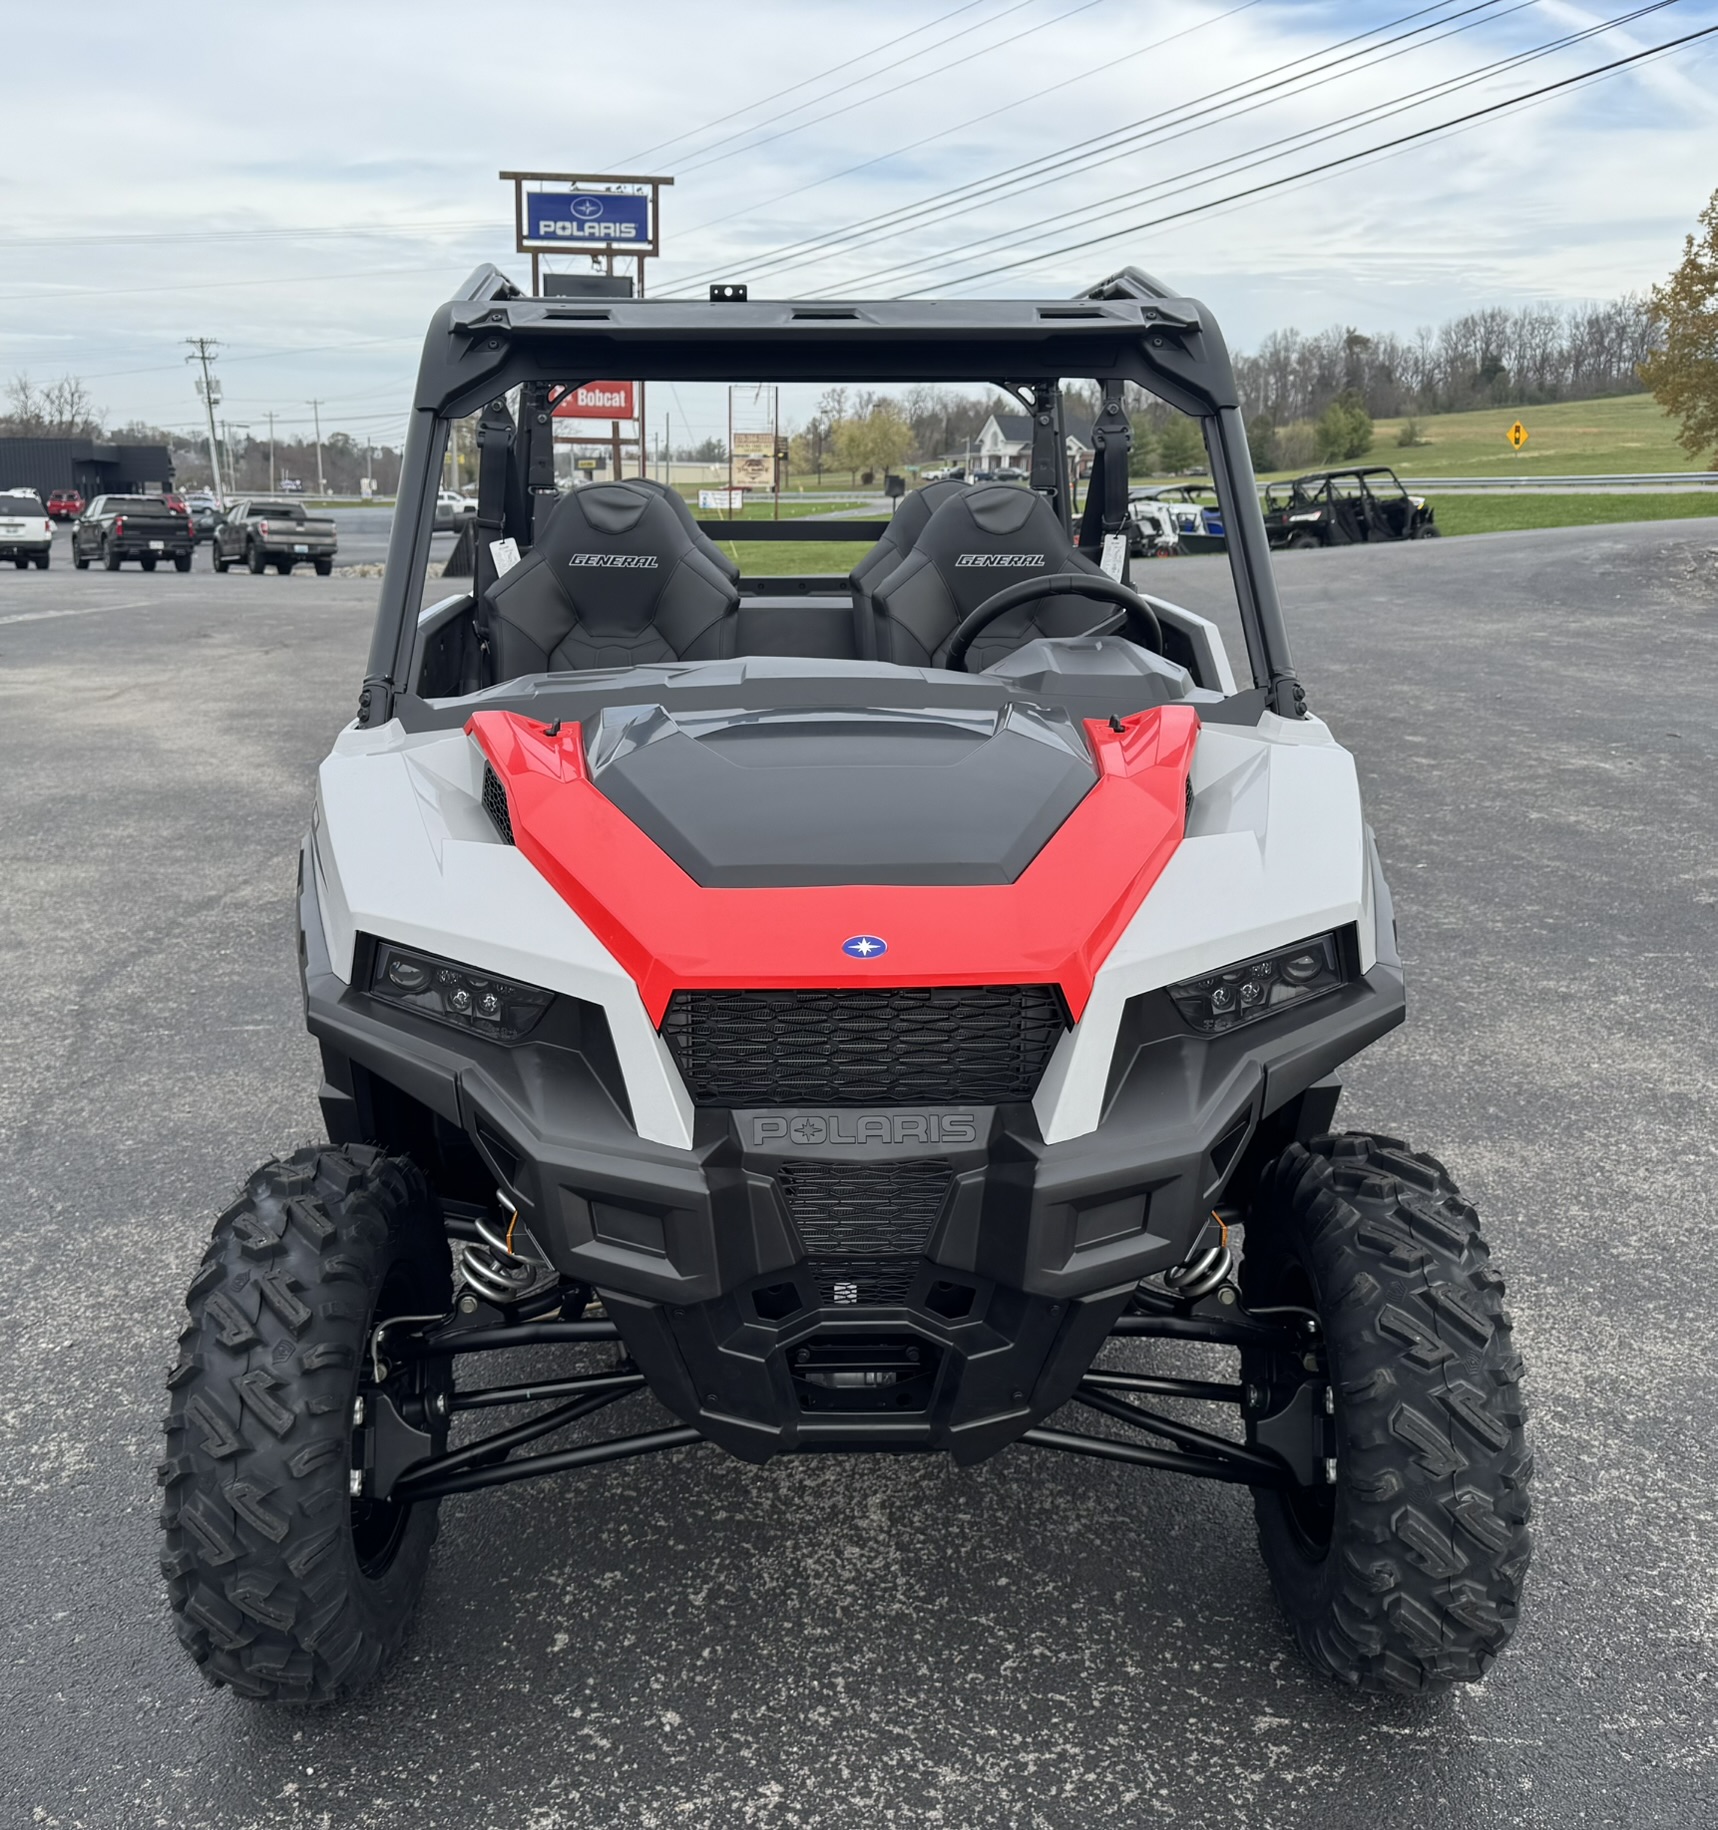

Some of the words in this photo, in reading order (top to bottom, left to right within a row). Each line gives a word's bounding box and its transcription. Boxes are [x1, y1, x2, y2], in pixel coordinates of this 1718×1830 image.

[539, 220, 636, 237] POLARIS
[577, 388, 626, 407] Bobcat
[569, 553, 658, 568] GENERAL
[955, 554, 1045, 567] GENERAL
[753, 1114, 976, 1145] POLARIS
